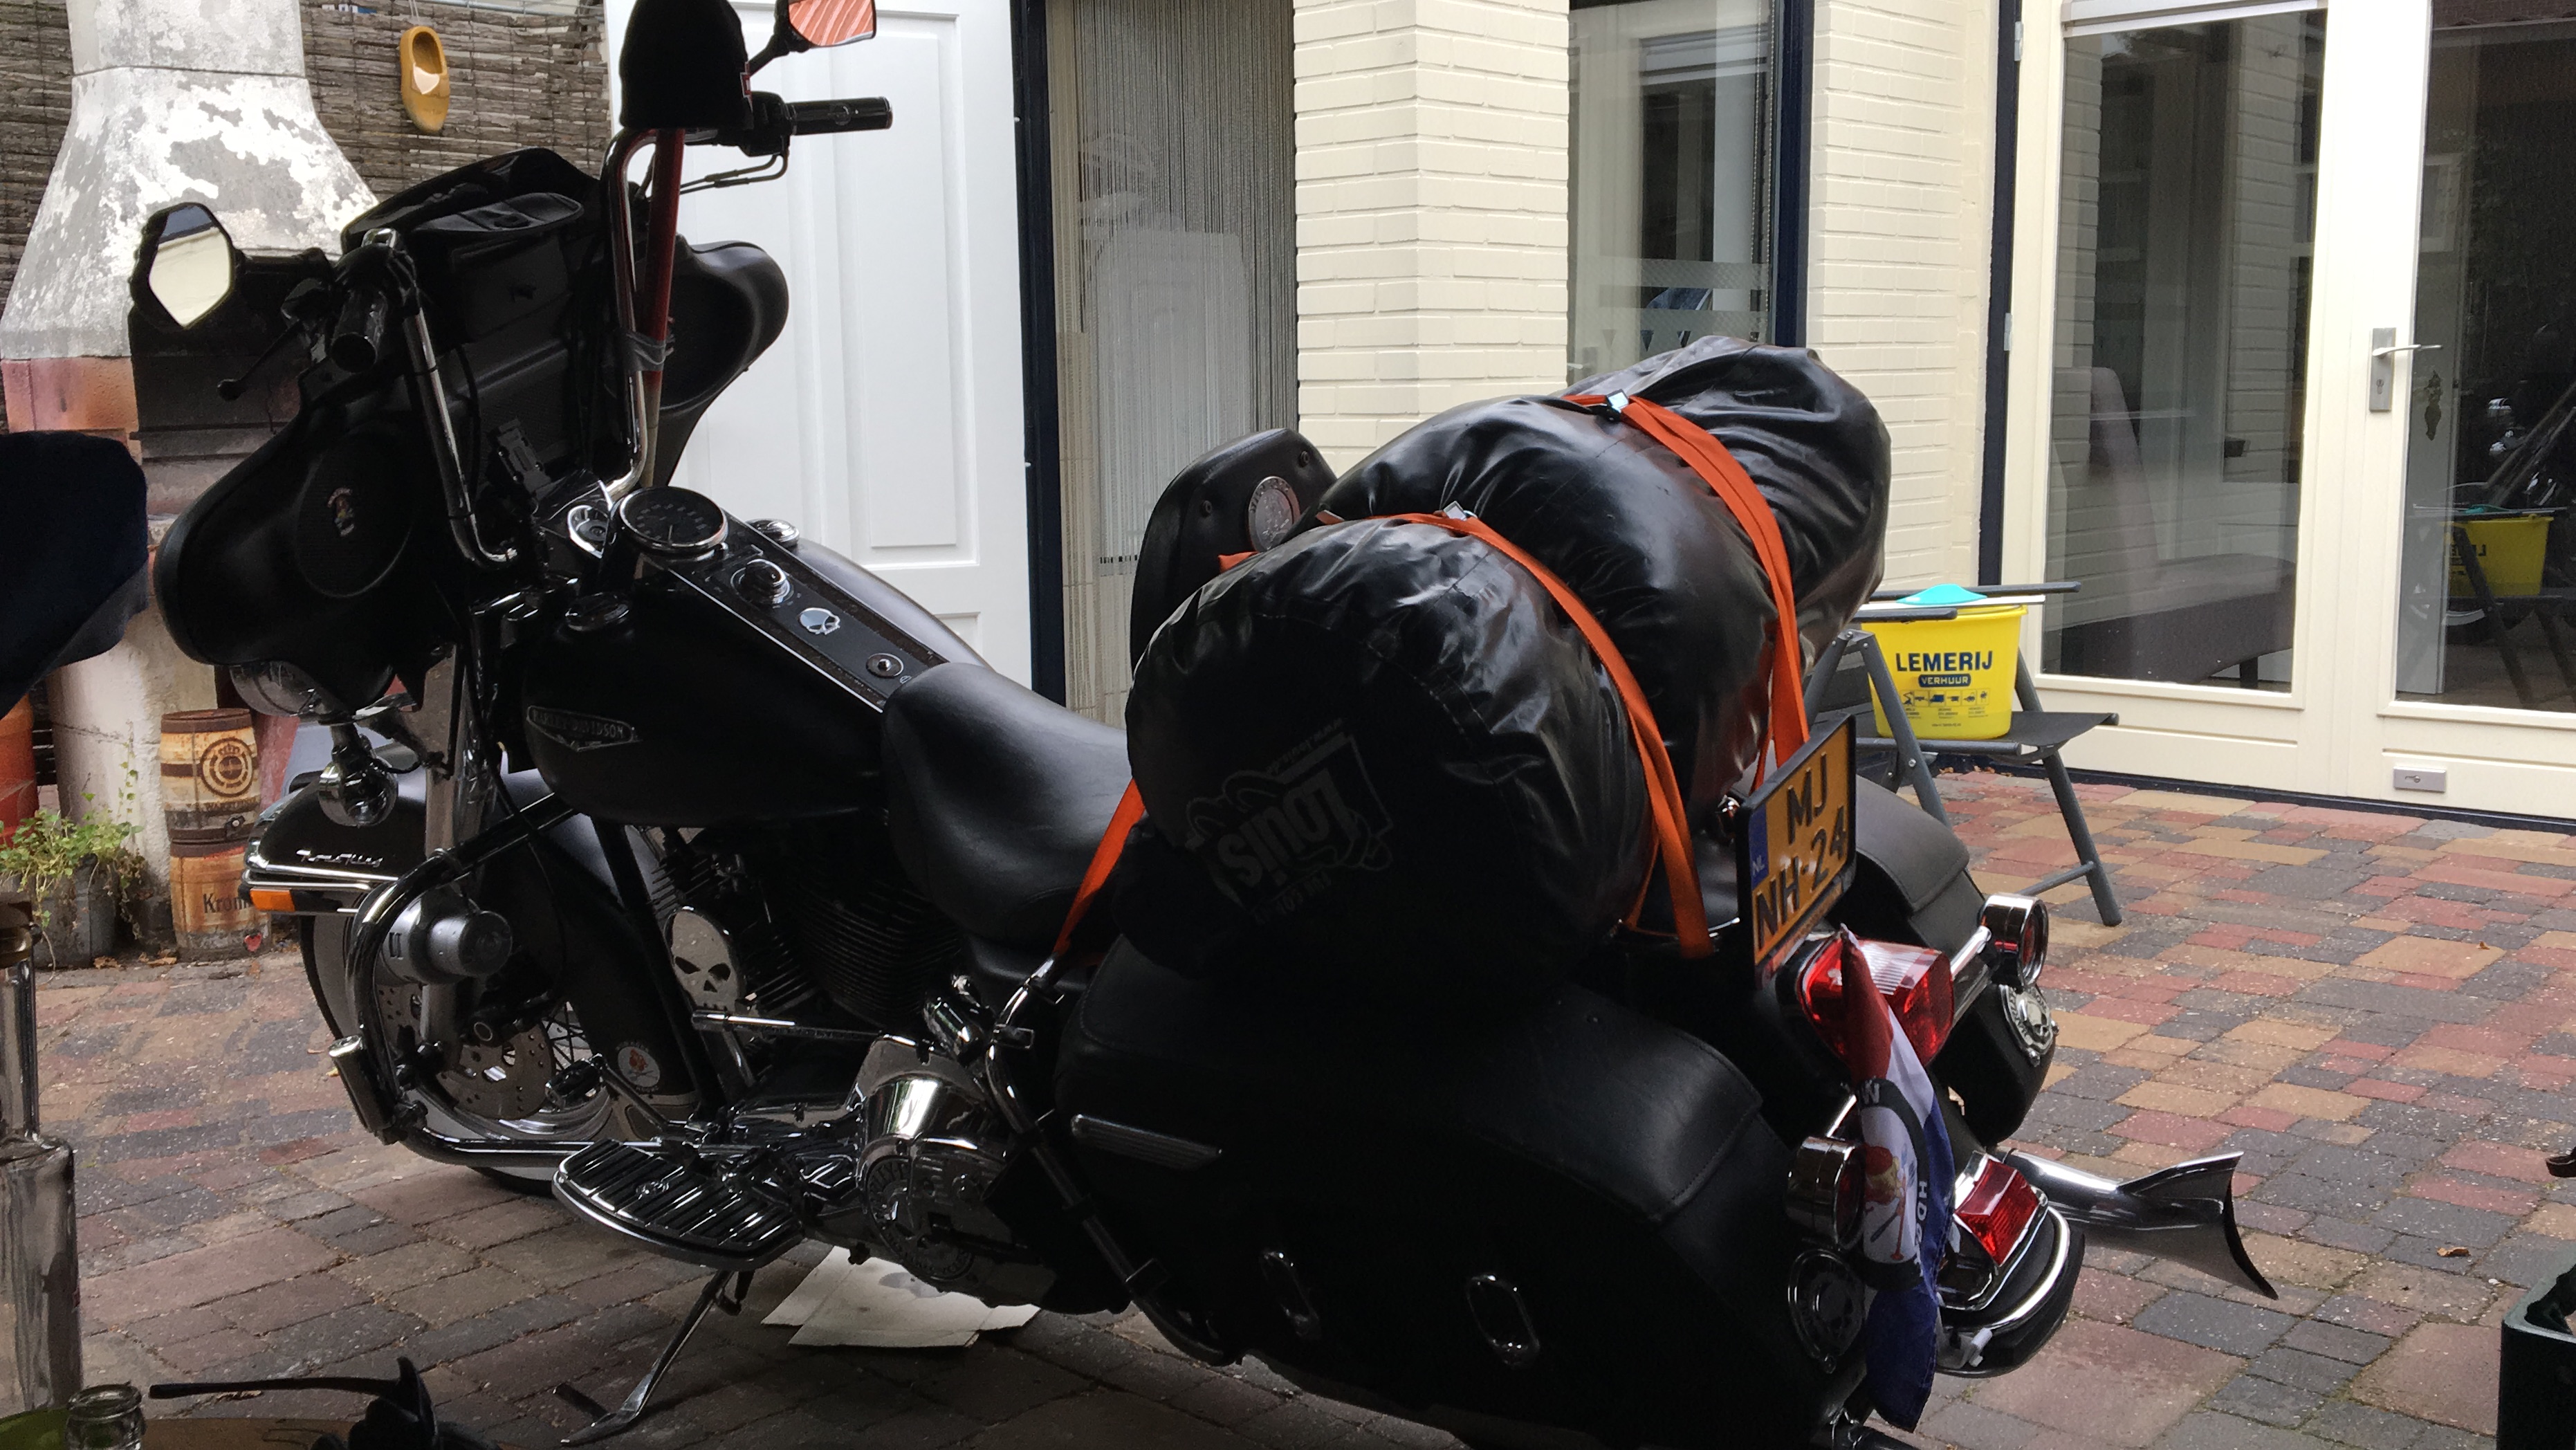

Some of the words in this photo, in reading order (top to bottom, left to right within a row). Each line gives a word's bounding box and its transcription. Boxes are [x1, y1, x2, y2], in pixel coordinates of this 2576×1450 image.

[1895, 651, 1993, 672] LEMERIJ
[1921, 676, 1969, 686] VERHUUR
[1787, 753, 1828, 844] MJ
[1752, 854, 1765, 878] NL
[1756, 805, 1847, 950] NH-24
